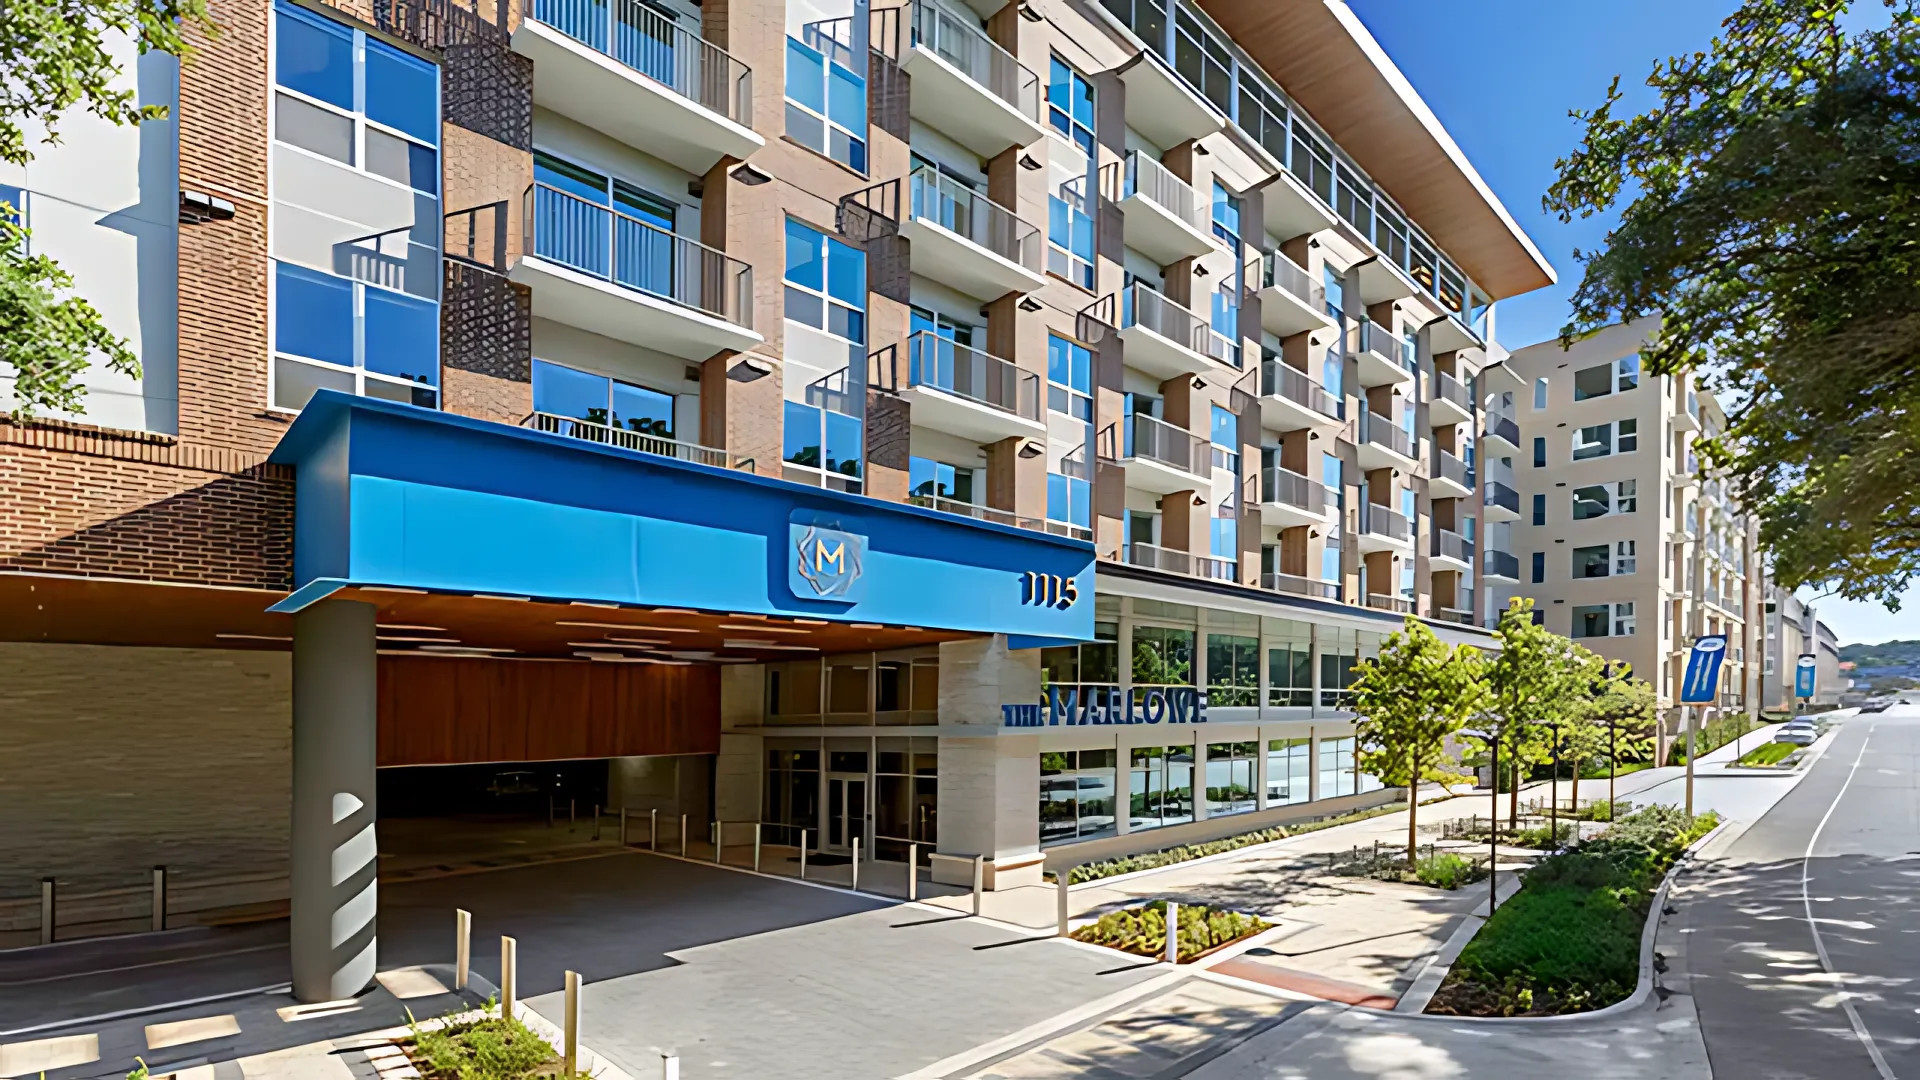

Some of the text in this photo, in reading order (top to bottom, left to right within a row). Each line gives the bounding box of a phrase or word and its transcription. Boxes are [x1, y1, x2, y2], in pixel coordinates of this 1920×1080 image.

[816, 538, 845, 574] M
[1023, 571, 1078, 607] 1115
[1002, 686, 1207, 727] THE MARLOWE
